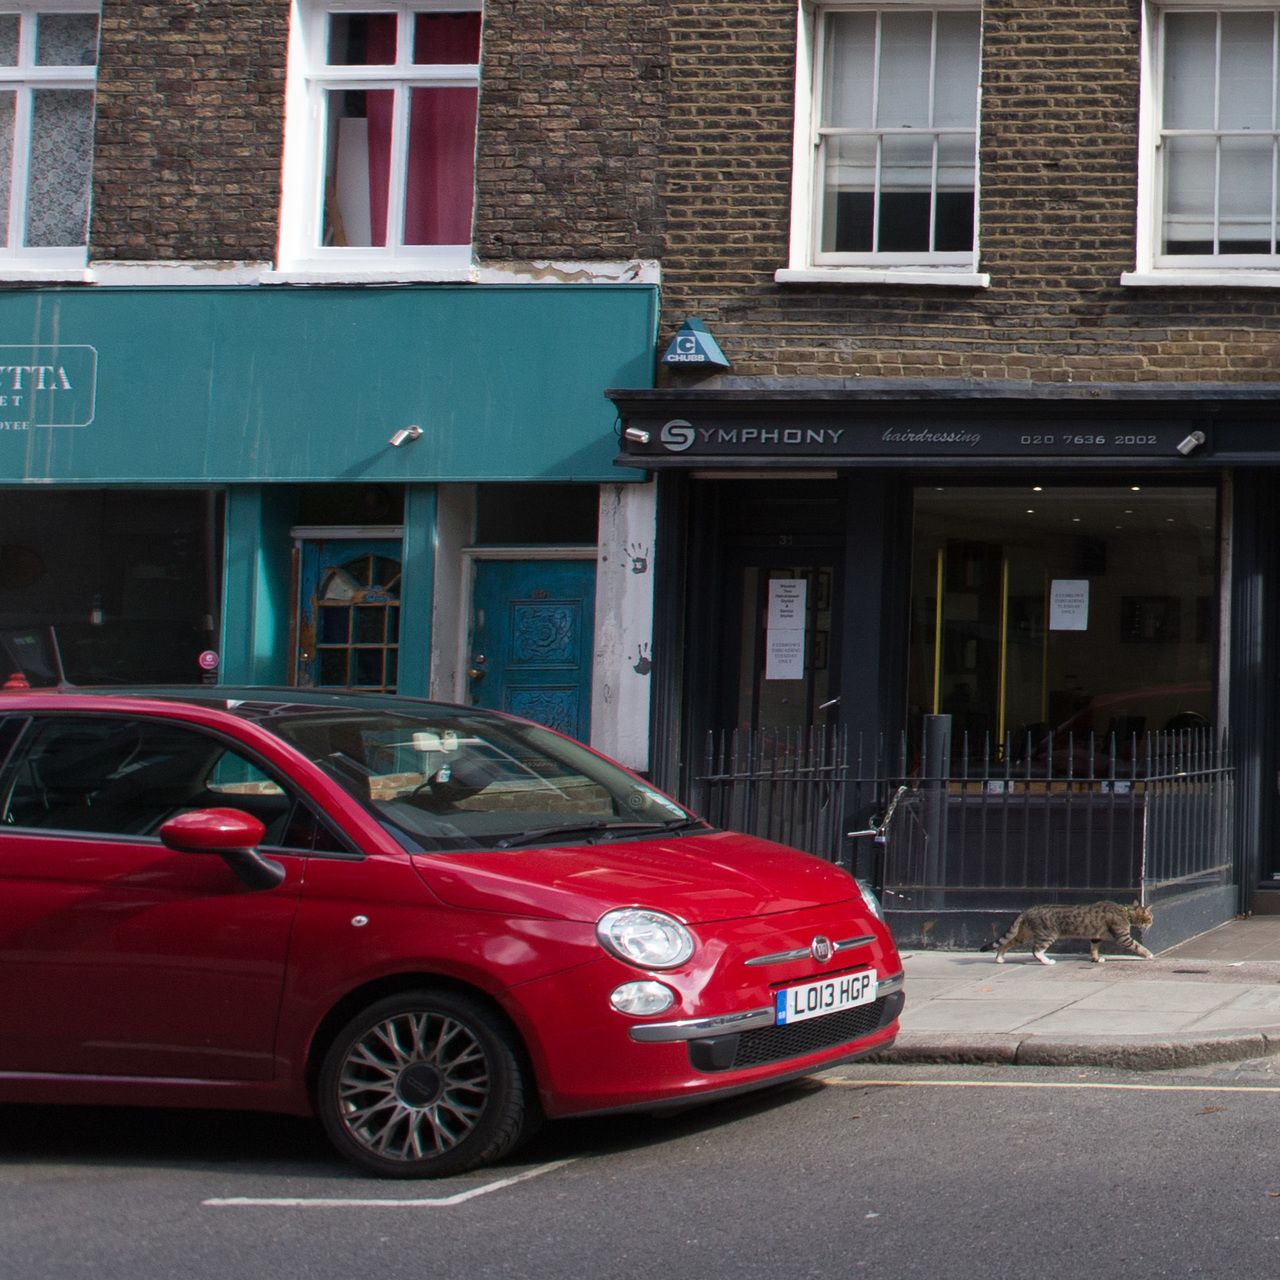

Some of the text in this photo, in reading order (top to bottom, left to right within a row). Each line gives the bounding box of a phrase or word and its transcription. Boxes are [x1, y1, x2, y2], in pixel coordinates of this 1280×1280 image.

[667, 354, 705, 362] CHUBB
[660, 419, 1158, 452] SYMPHONY hairdressing 020 7636 2002
[794, 974, 870, 1015] LO13 HGP
